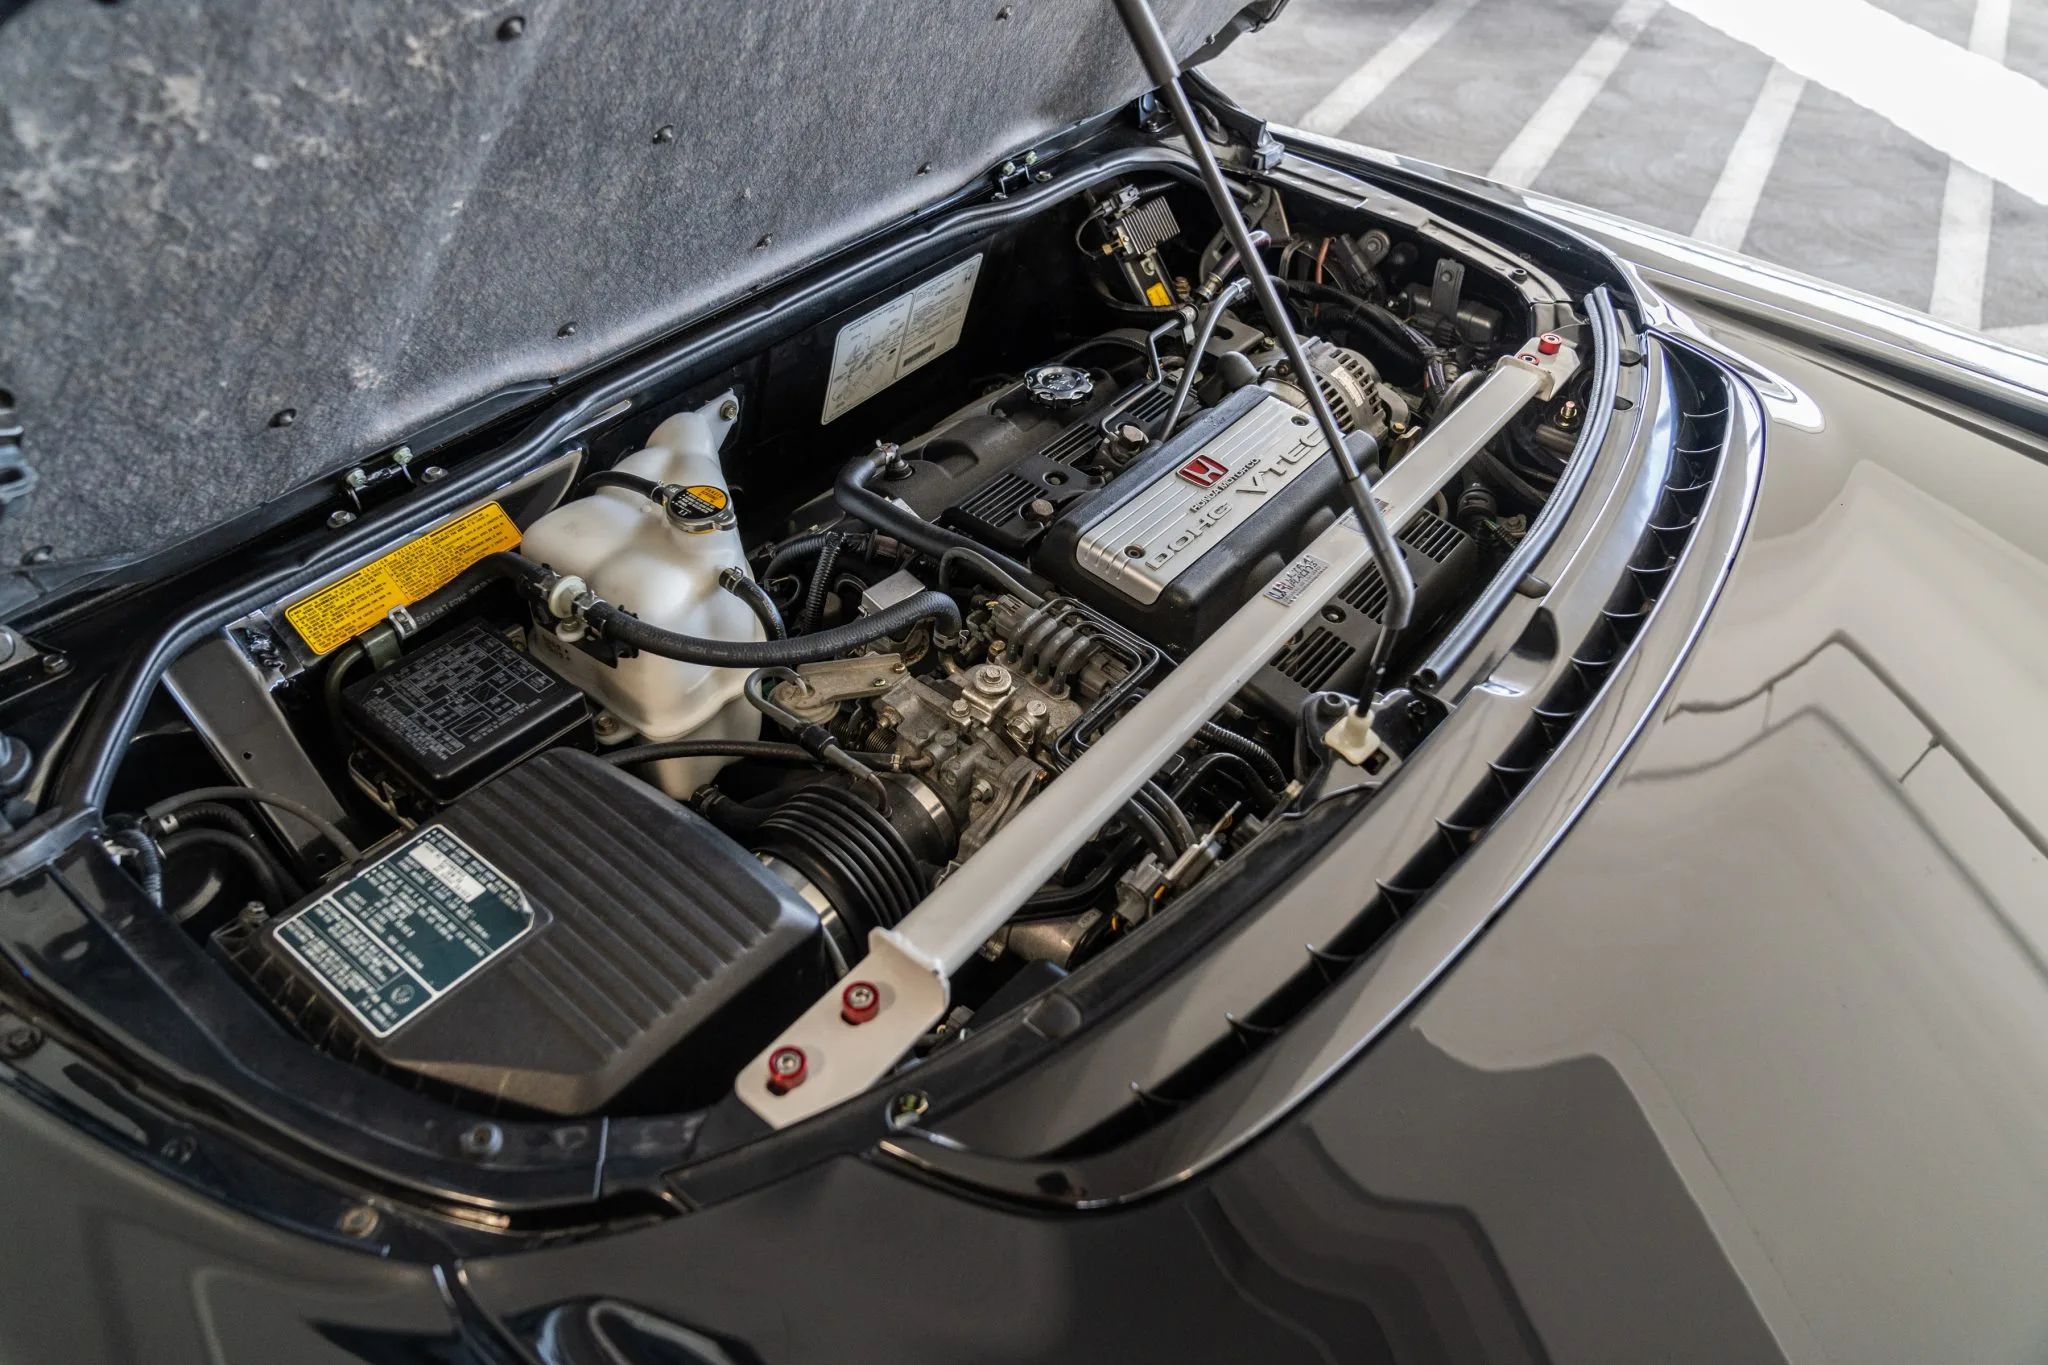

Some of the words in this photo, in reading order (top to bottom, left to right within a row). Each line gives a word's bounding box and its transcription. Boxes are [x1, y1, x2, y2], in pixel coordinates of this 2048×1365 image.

[1145, 502, 1232, 571] DOHC
[1235, 427, 1326, 496] VTEC
[1190, 487, 1222, 513] HONDA
[1220, 466, 1248, 491] MOTOR
